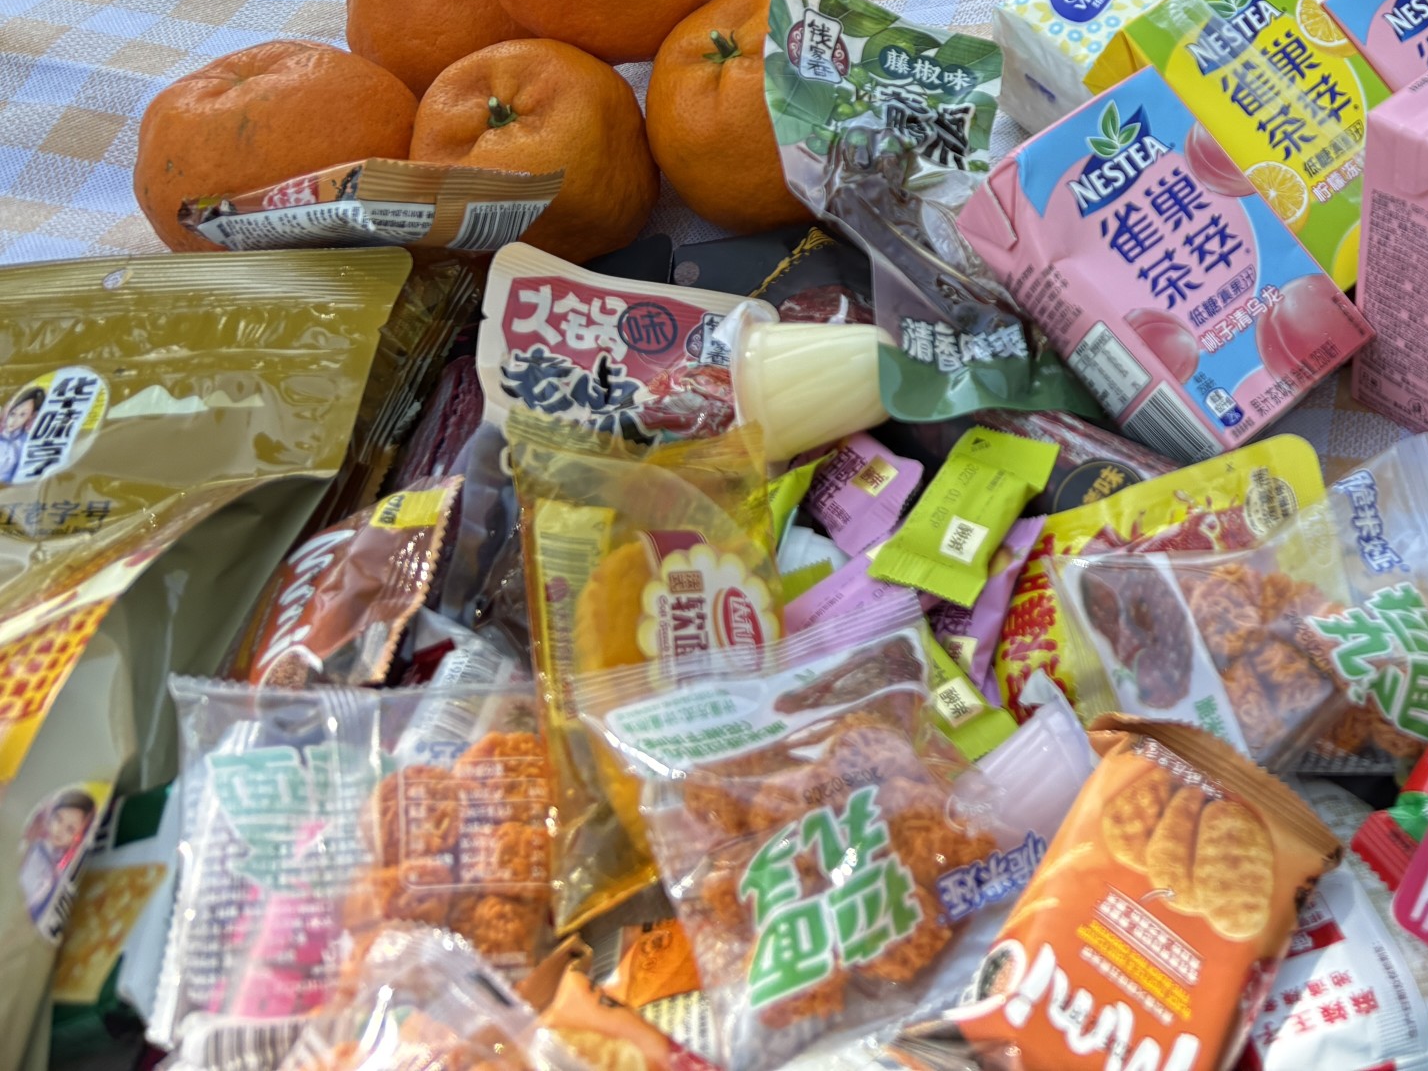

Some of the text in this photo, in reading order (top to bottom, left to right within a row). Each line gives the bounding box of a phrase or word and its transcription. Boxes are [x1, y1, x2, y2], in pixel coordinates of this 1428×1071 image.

[884, 49, 973, 92] 藤椒味
[1186, 0, 1284, 69] NESTEA
[1220, 29, 1322, 117] 雀巢
[1256, 72, 1353, 162] 茶萃
[1068, 134, 1173, 210] NESTEA
[1100, 165, 1214, 265] 雀巢
[1136, 212, 1246, 311] 茶萃
[1187, 264, 1257, 328] 低糖真果汁
[1199, 283, 1286, 354] 桃子清乌龙
[23, 375, 99, 478] 华味亨
[749, 859, 918, 1006] 拉面
[1257, 985, 1380, 1047] 麻辣王子
